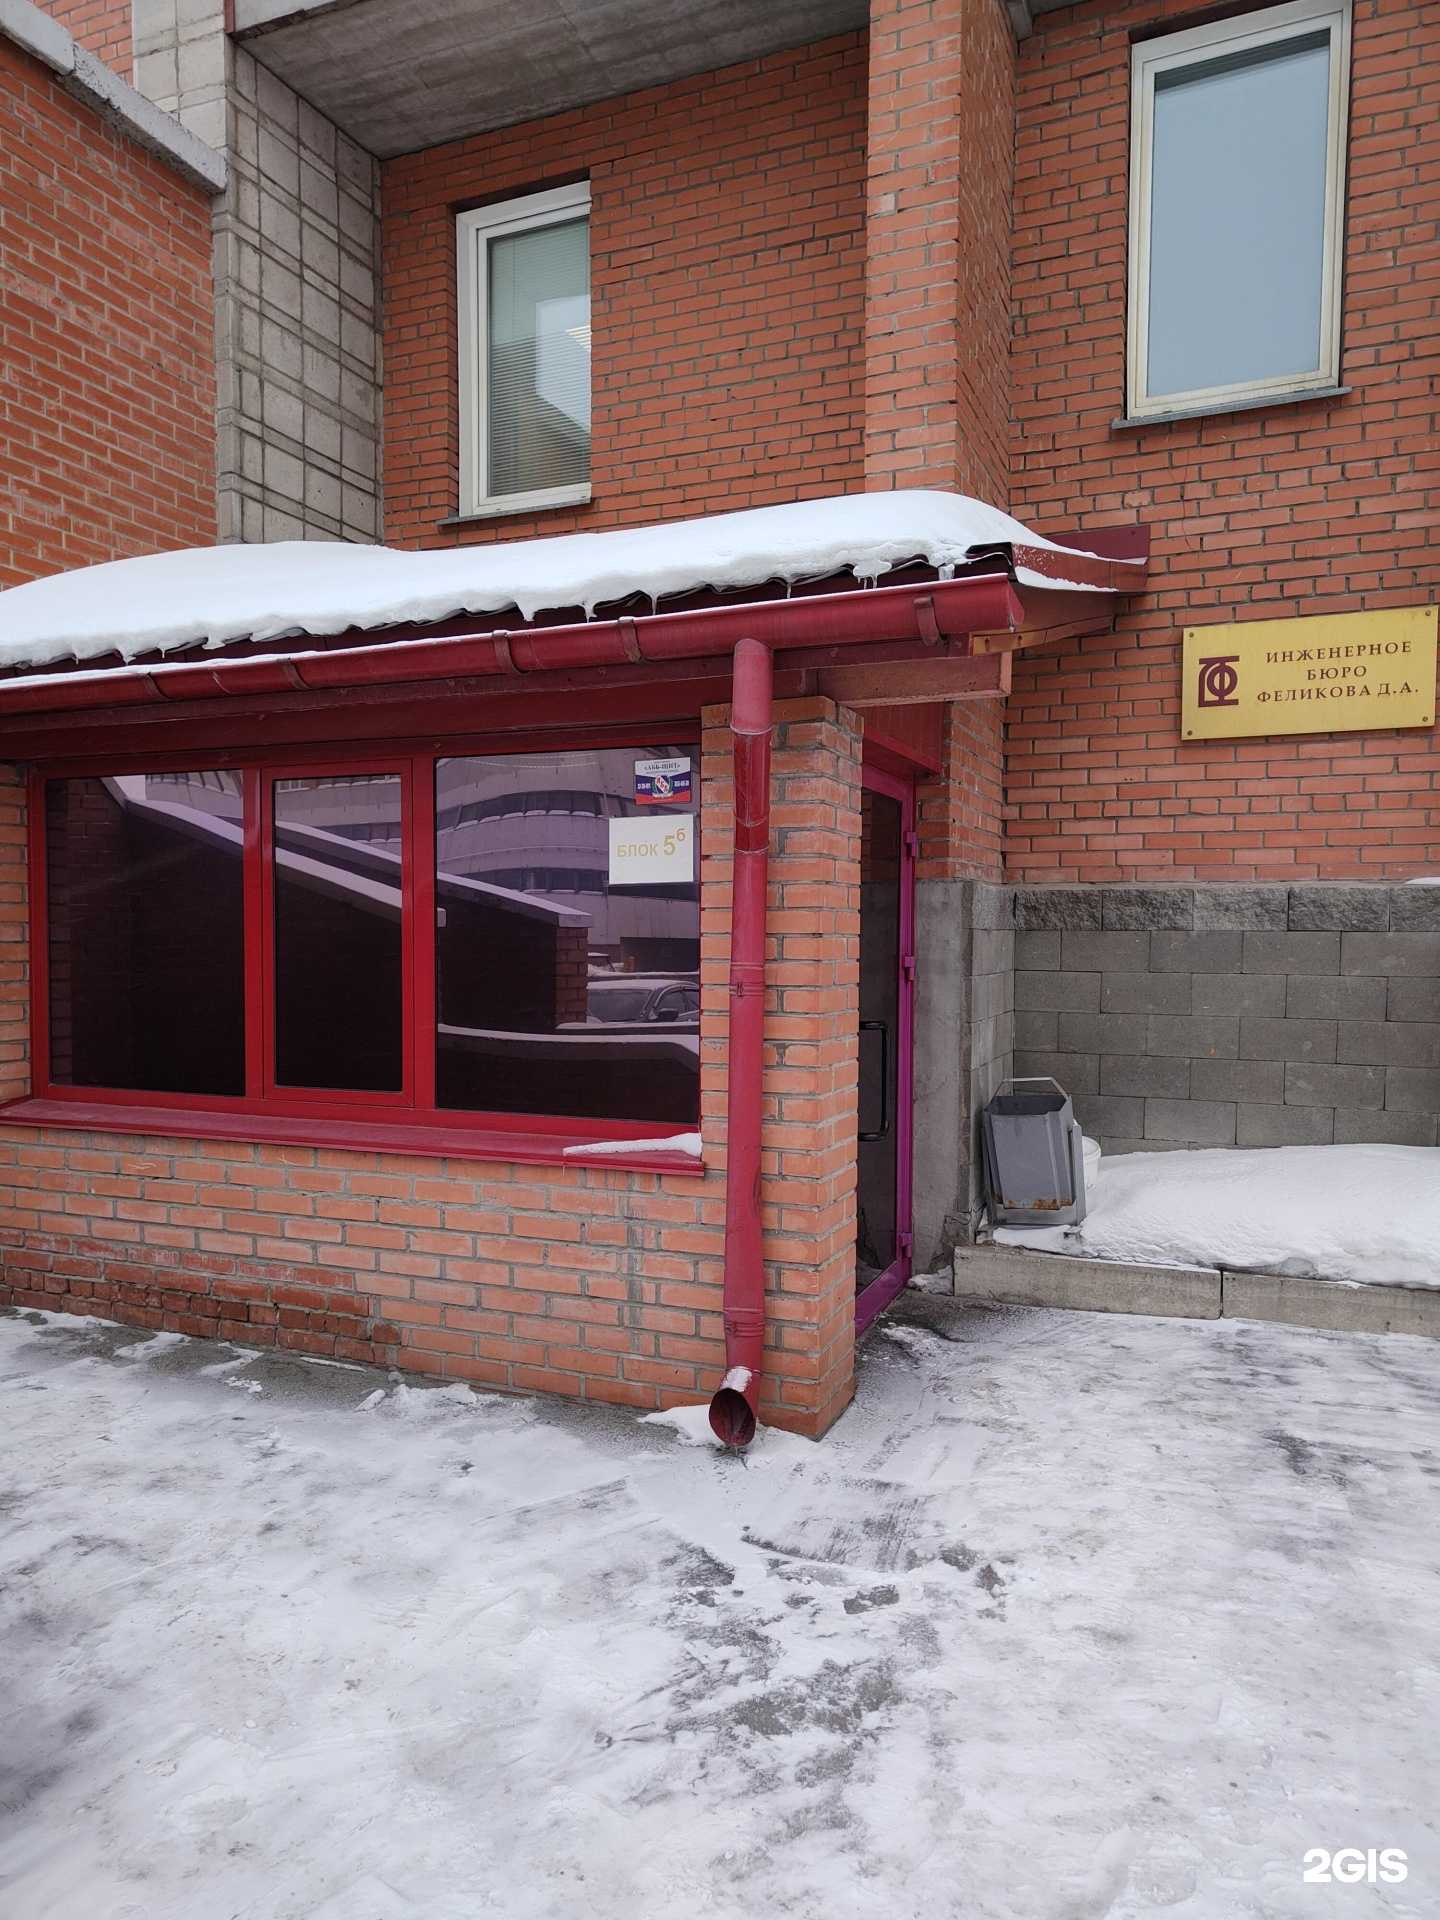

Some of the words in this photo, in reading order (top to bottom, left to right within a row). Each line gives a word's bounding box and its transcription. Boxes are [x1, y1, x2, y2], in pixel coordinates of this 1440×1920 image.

[1266, 641, 1412, 663] ИНЖЕНЕРНОЕ
[1307, 665, 1367, 681] БЮРО
[1257, 684, 1371, 703] ФЕЛИКОВА
[1377, 681, 1419, 696] Д.А.
[616, 843, 658, 857] БЛОК
